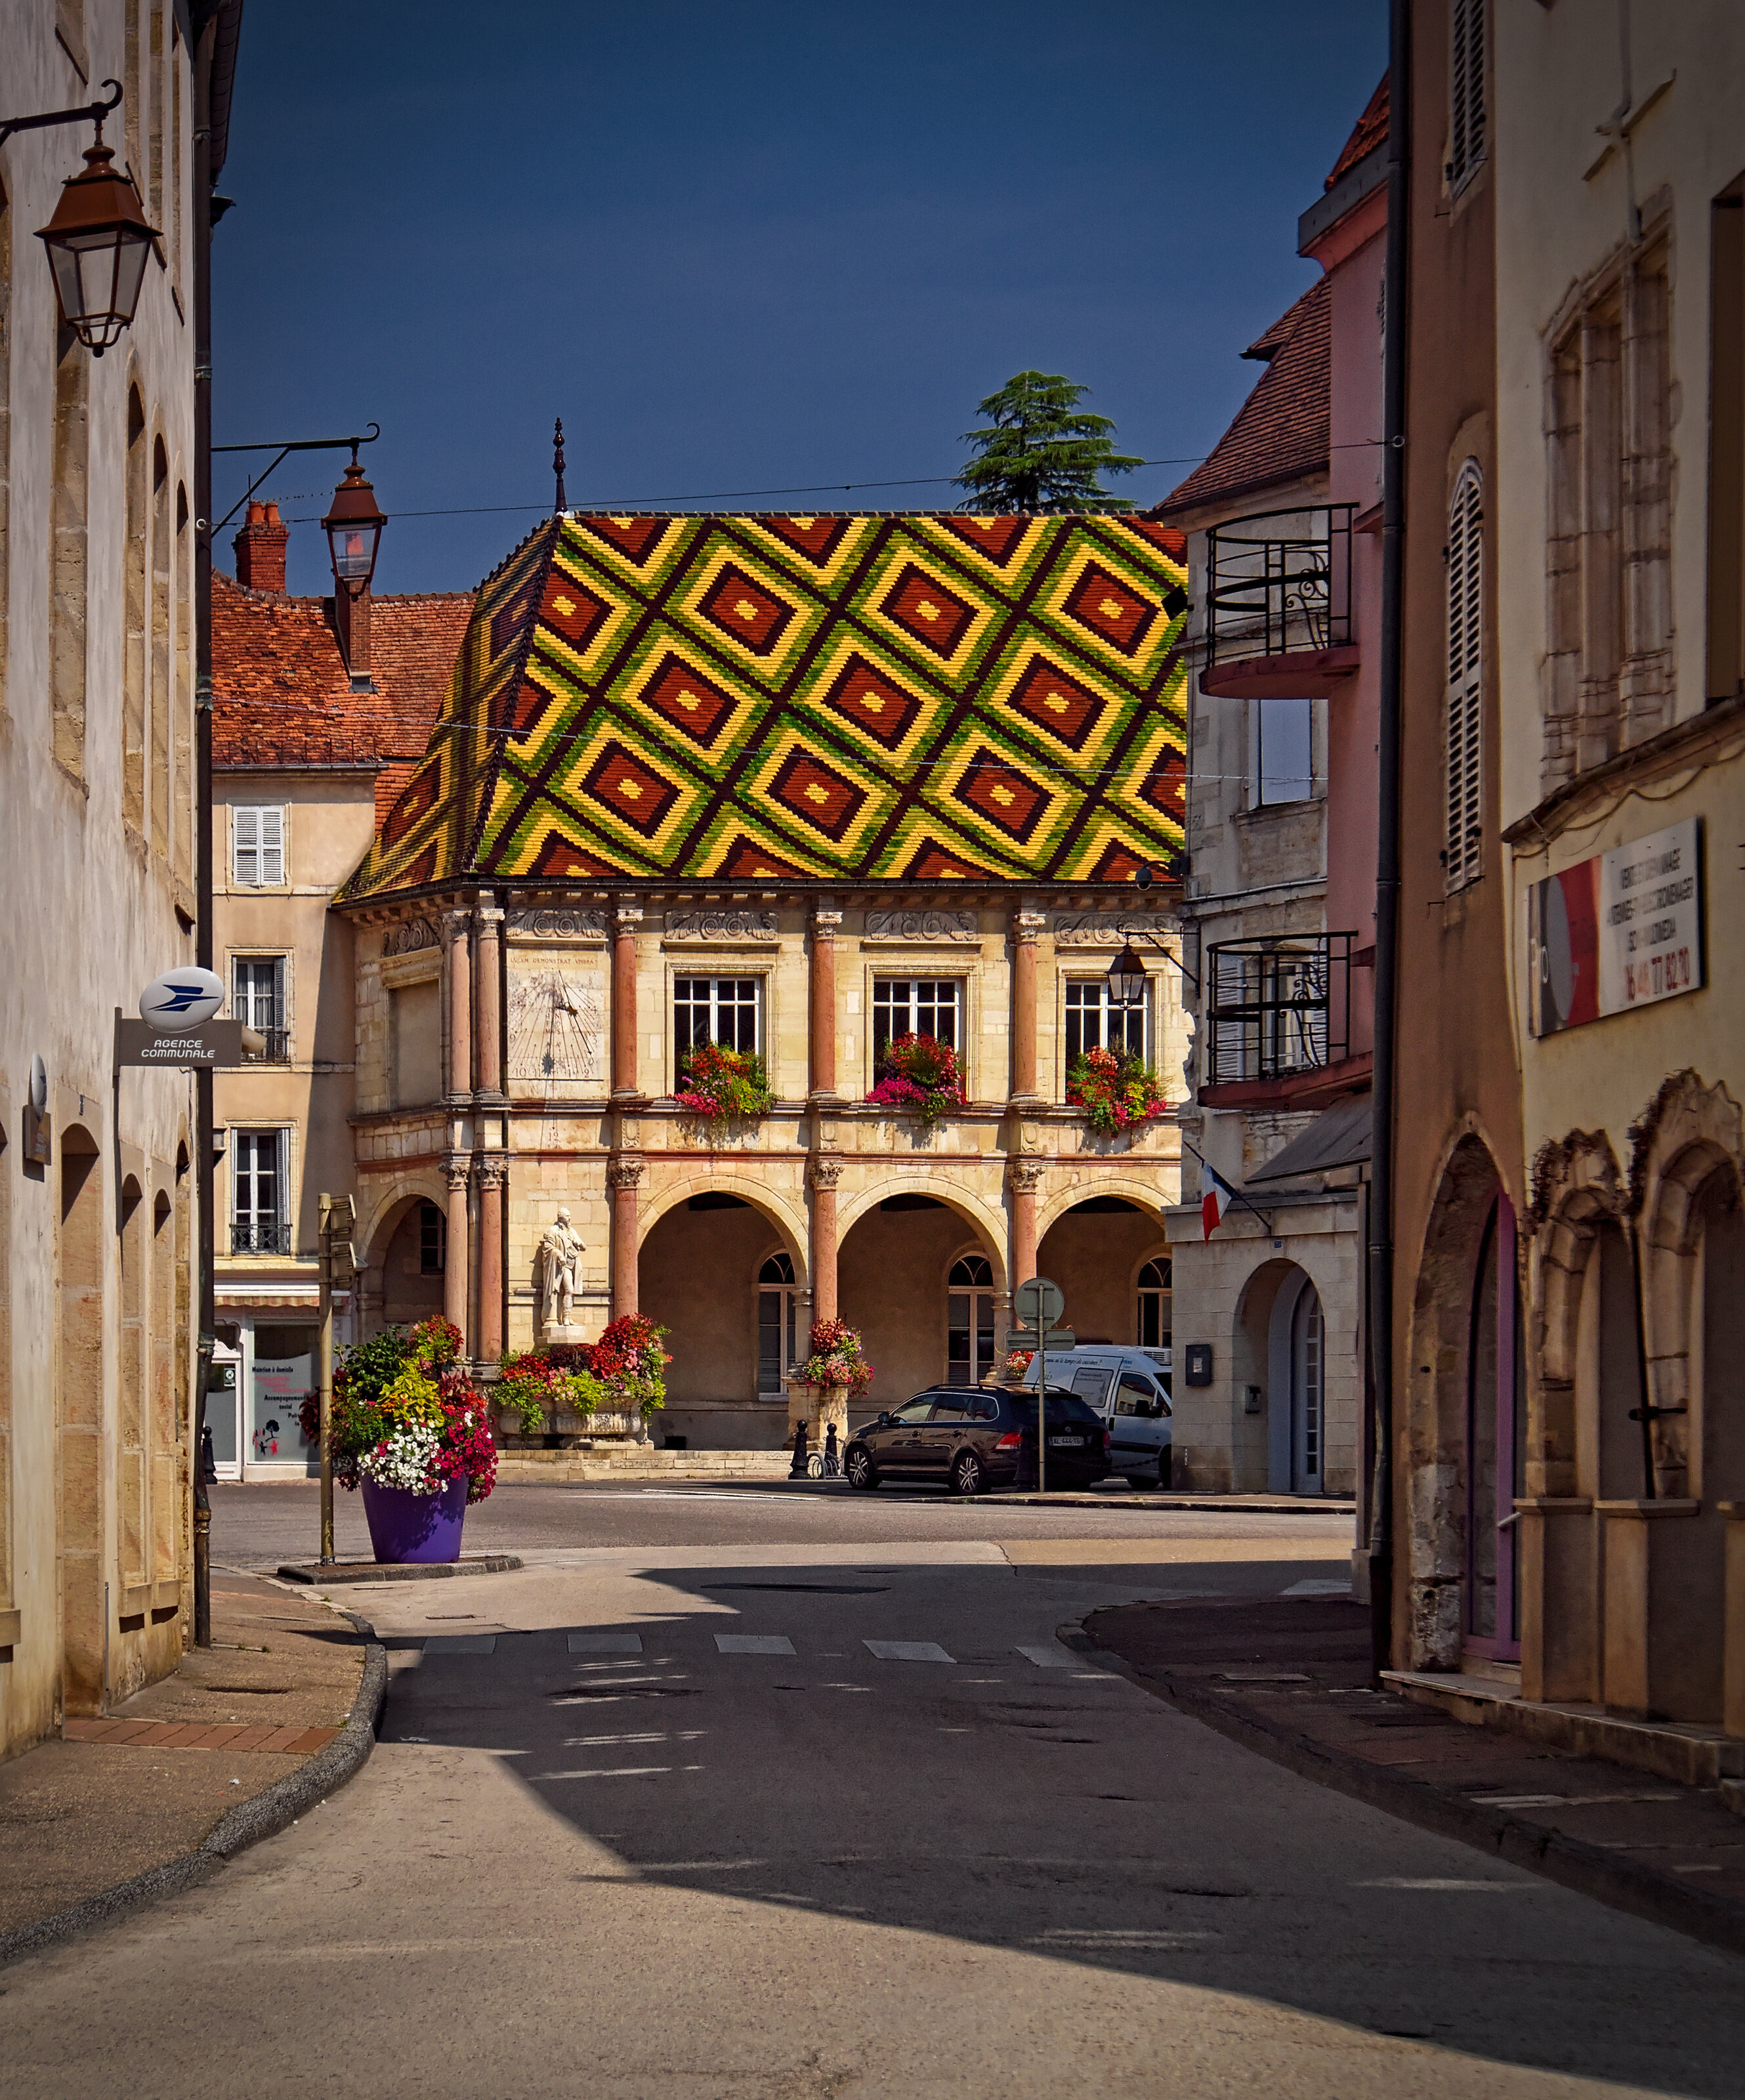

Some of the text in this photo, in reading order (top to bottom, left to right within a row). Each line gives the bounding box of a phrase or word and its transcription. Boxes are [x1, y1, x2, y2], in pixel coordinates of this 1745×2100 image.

[154, 1040, 203, 1049] AGENCE
[141, 1049, 215, 1058] COMMUNALE
[515, 1068, 526, 1077] 10
[549, 1132, 558, 1141] 12
